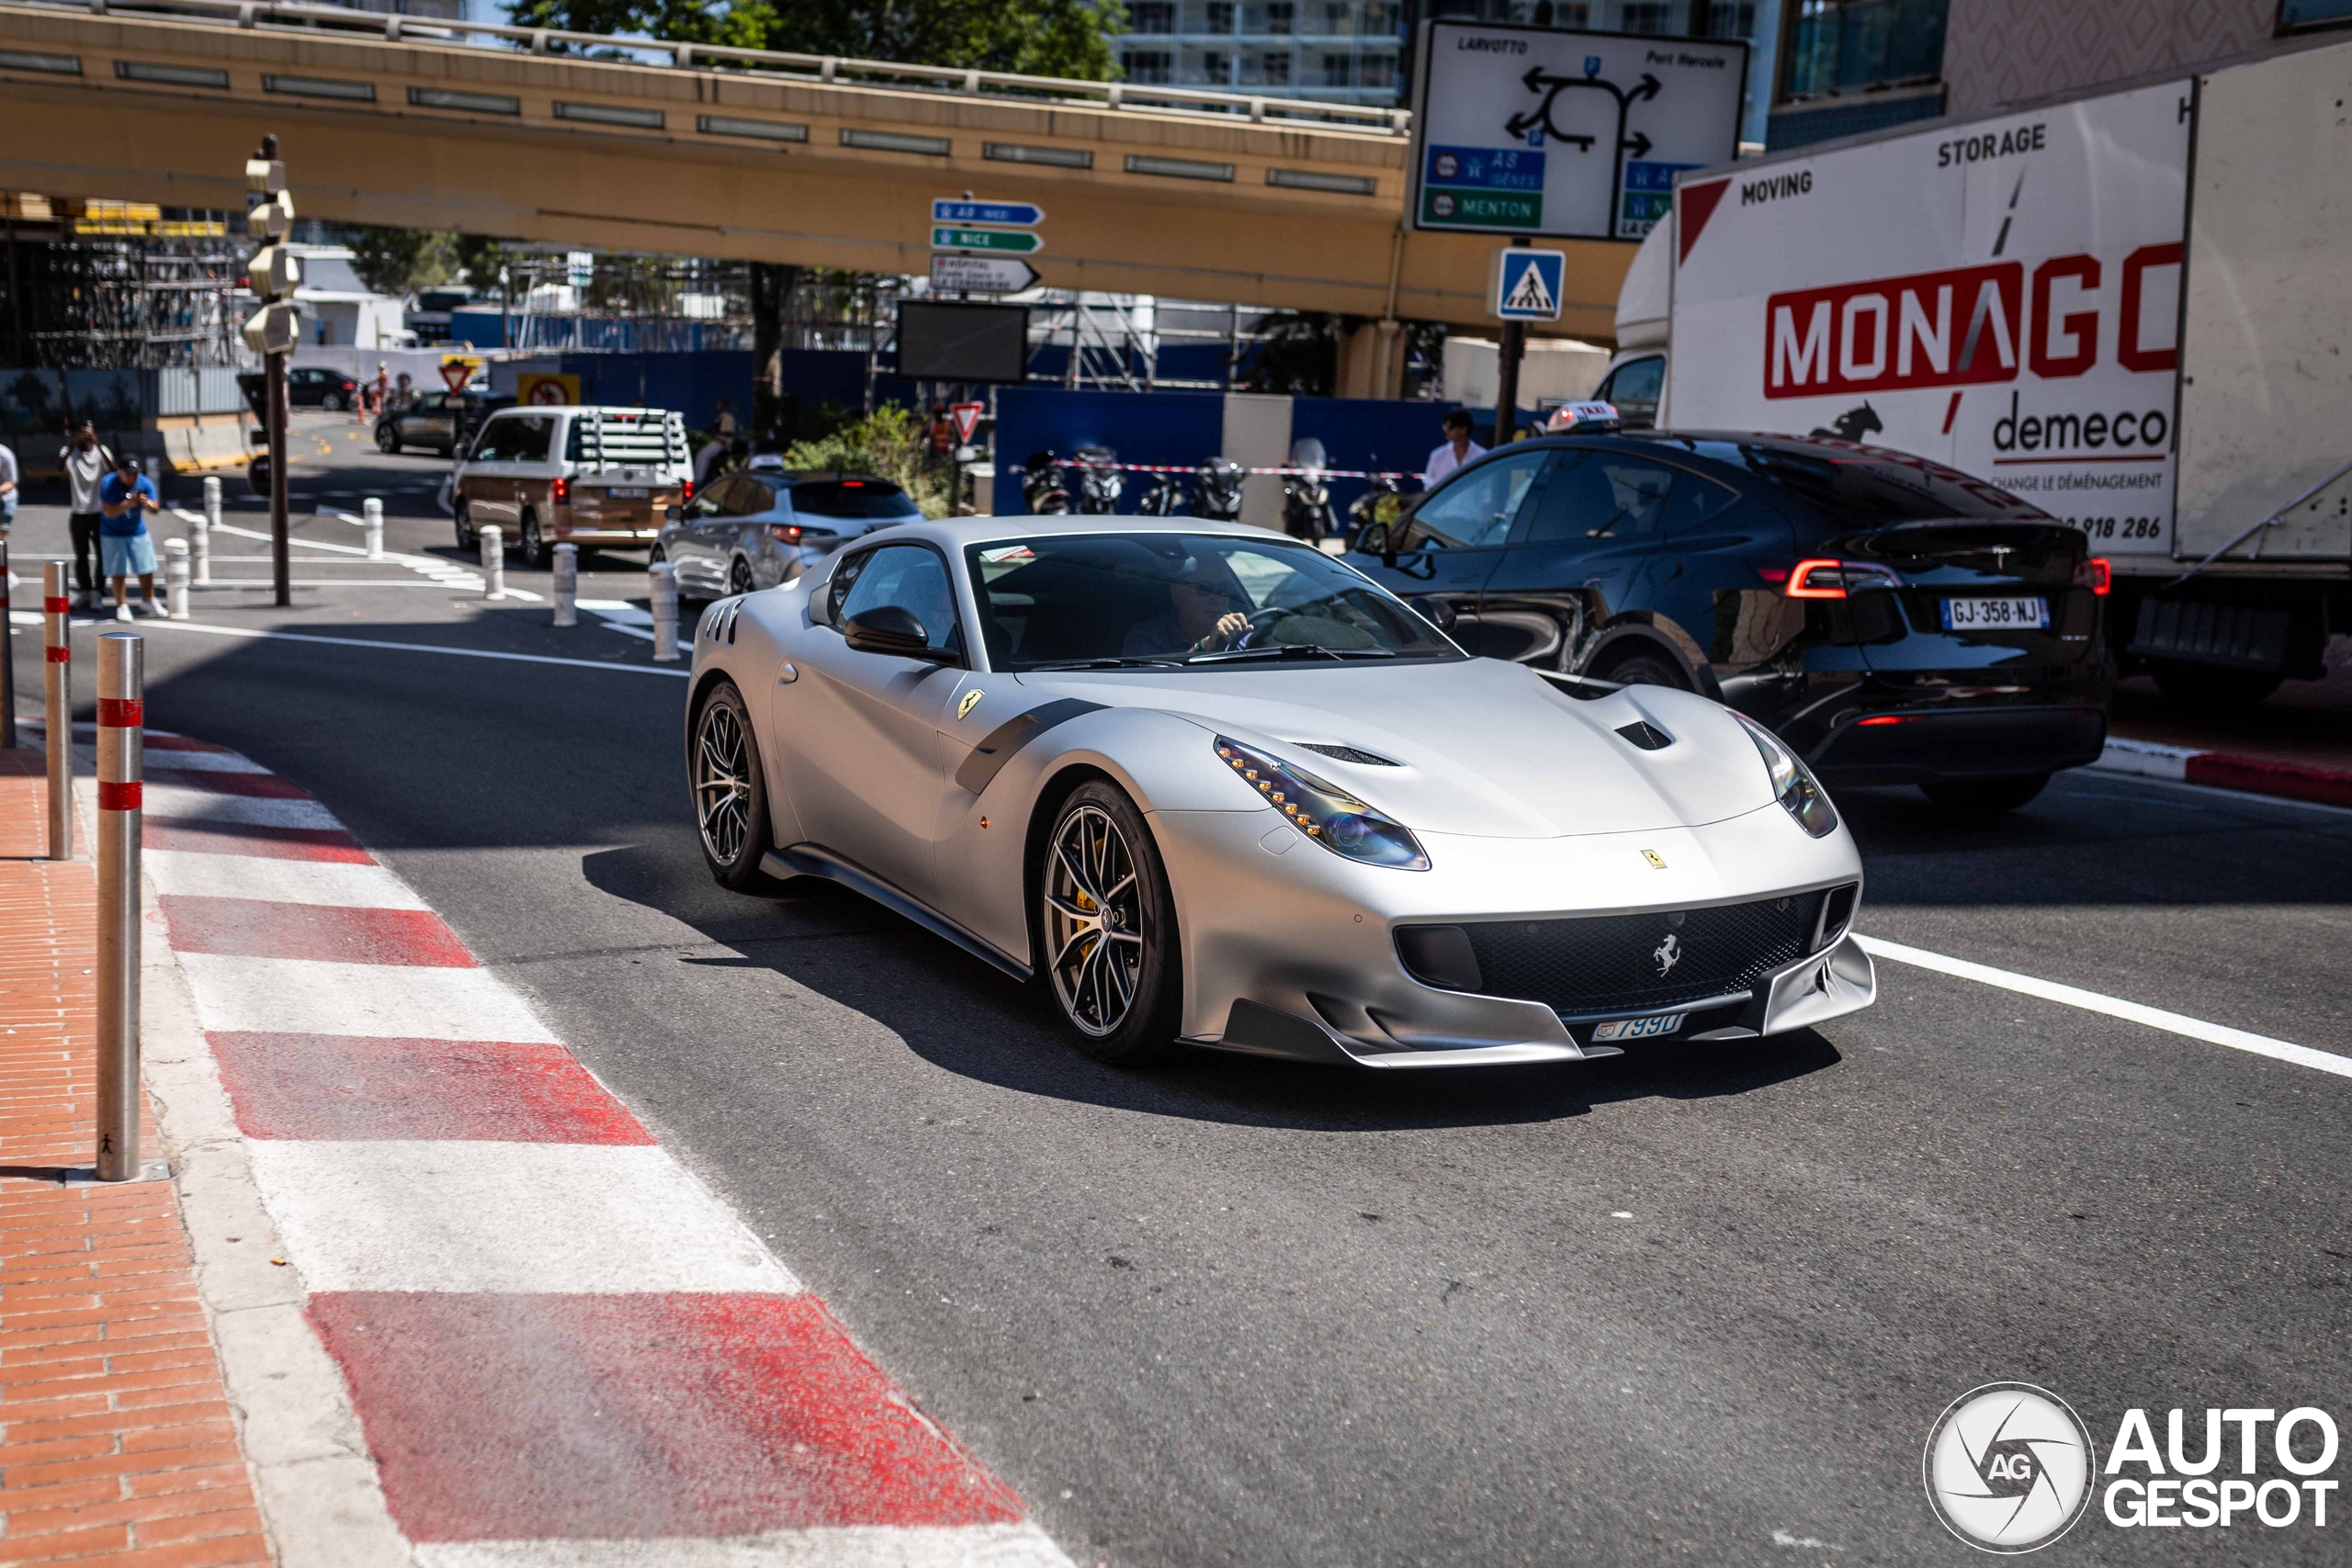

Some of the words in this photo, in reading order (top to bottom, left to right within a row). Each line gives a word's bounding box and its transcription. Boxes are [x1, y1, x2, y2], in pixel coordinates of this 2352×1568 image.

[1458, 37, 1529, 55] LARVOTTO
[1938, 123, 2047, 169] STORAGE
[1741, 169, 1813, 208] MOVING
[1462, 198, 1532, 218] MENTON
[960, 232, 990, 246] NICE
[1577, 405, 1608, 417] TAXI
[1993, 389, 2168, 452] demeco
[1990, 474, 2040, 492] CHANGE
[2042, 474, 2055, 491] LE
[2057, 470, 2163, 491] DÉMÉNAGEMENT
[2121, 515, 2161, 539] 286
